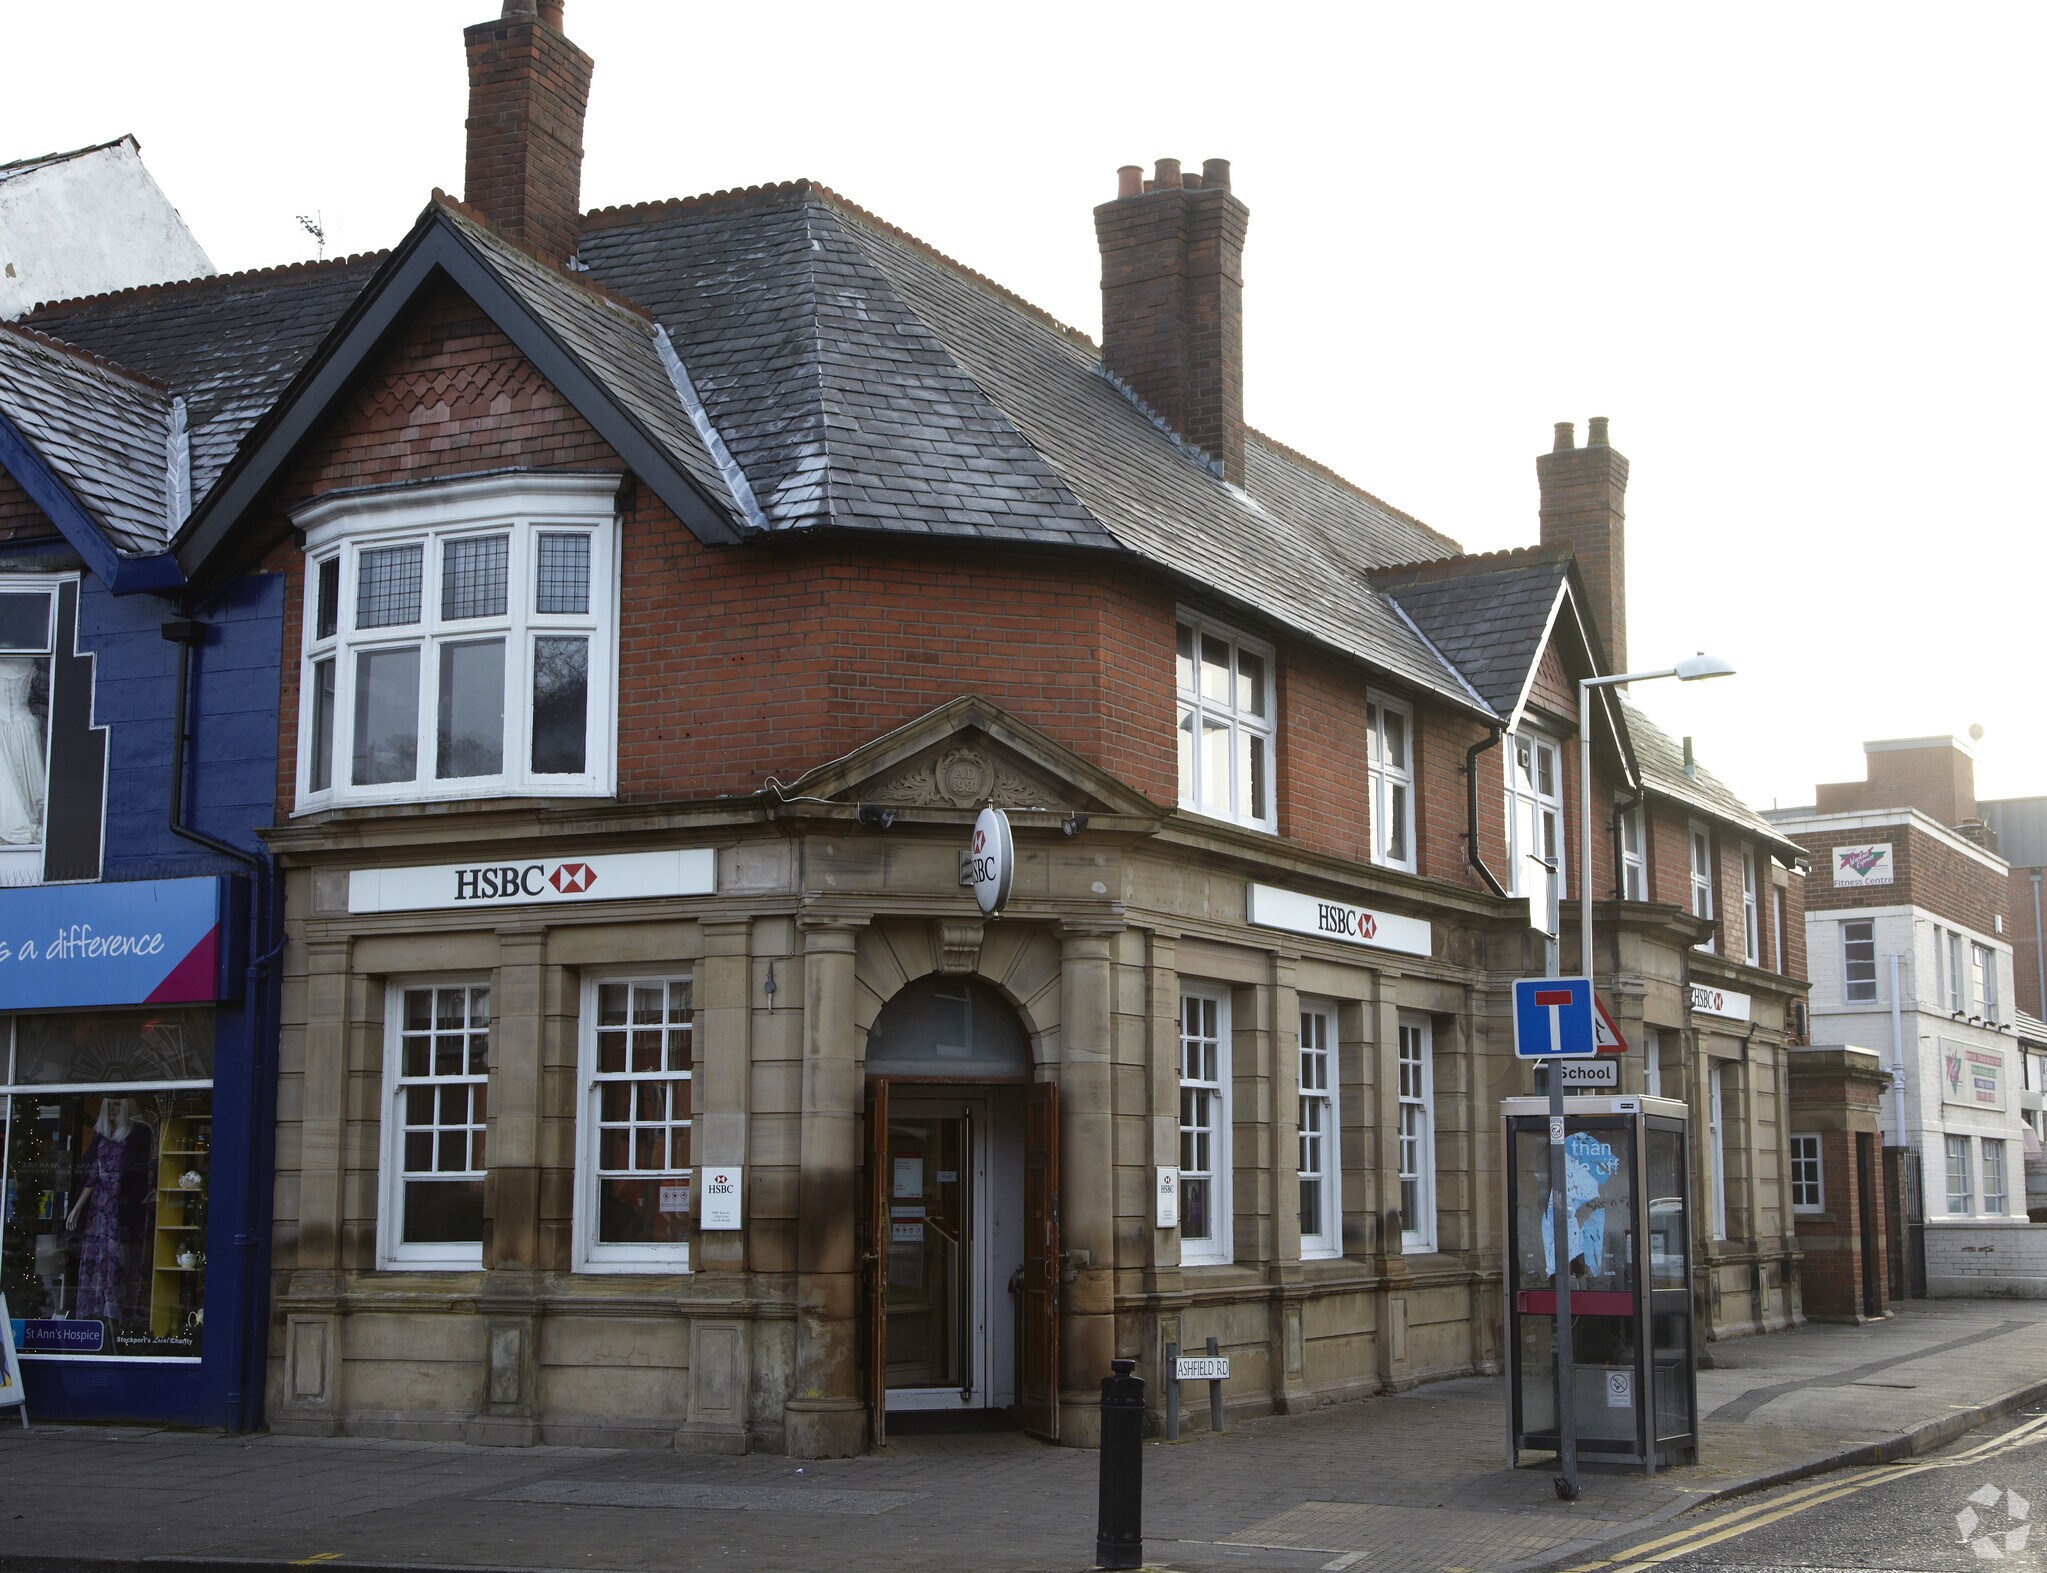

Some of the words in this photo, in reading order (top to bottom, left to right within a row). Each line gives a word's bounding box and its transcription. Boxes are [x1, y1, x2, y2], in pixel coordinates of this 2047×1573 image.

[972, 856, 997, 884] SBC
[454, 864, 545, 900] HSBC
[1834, 879, 1863, 887] Fitness
[1864, 877, 1893, 885] Centre
[1317, 903, 1357, 937] HSBC
[18, 940, 39, 961] a
[45, 924, 165, 960] difference
[1694, 988, 1714, 1010] HSBC
[708, 1184, 734, 1194] HSBC
[1160, 1184, 1175, 1193] HSBC
[25, 1327, 36, 1339] St
[36, 1328, 62, 1340] Ann's
[63, 1328, 100, 1342] Hospice
[116, 1335, 151, 1344] Stockport's
[170, 1336, 193, 1346] Charity
[1177, 1360, 1215, 1376] ASHFIELD
[1216, 1360, 1229, 1376] RD
